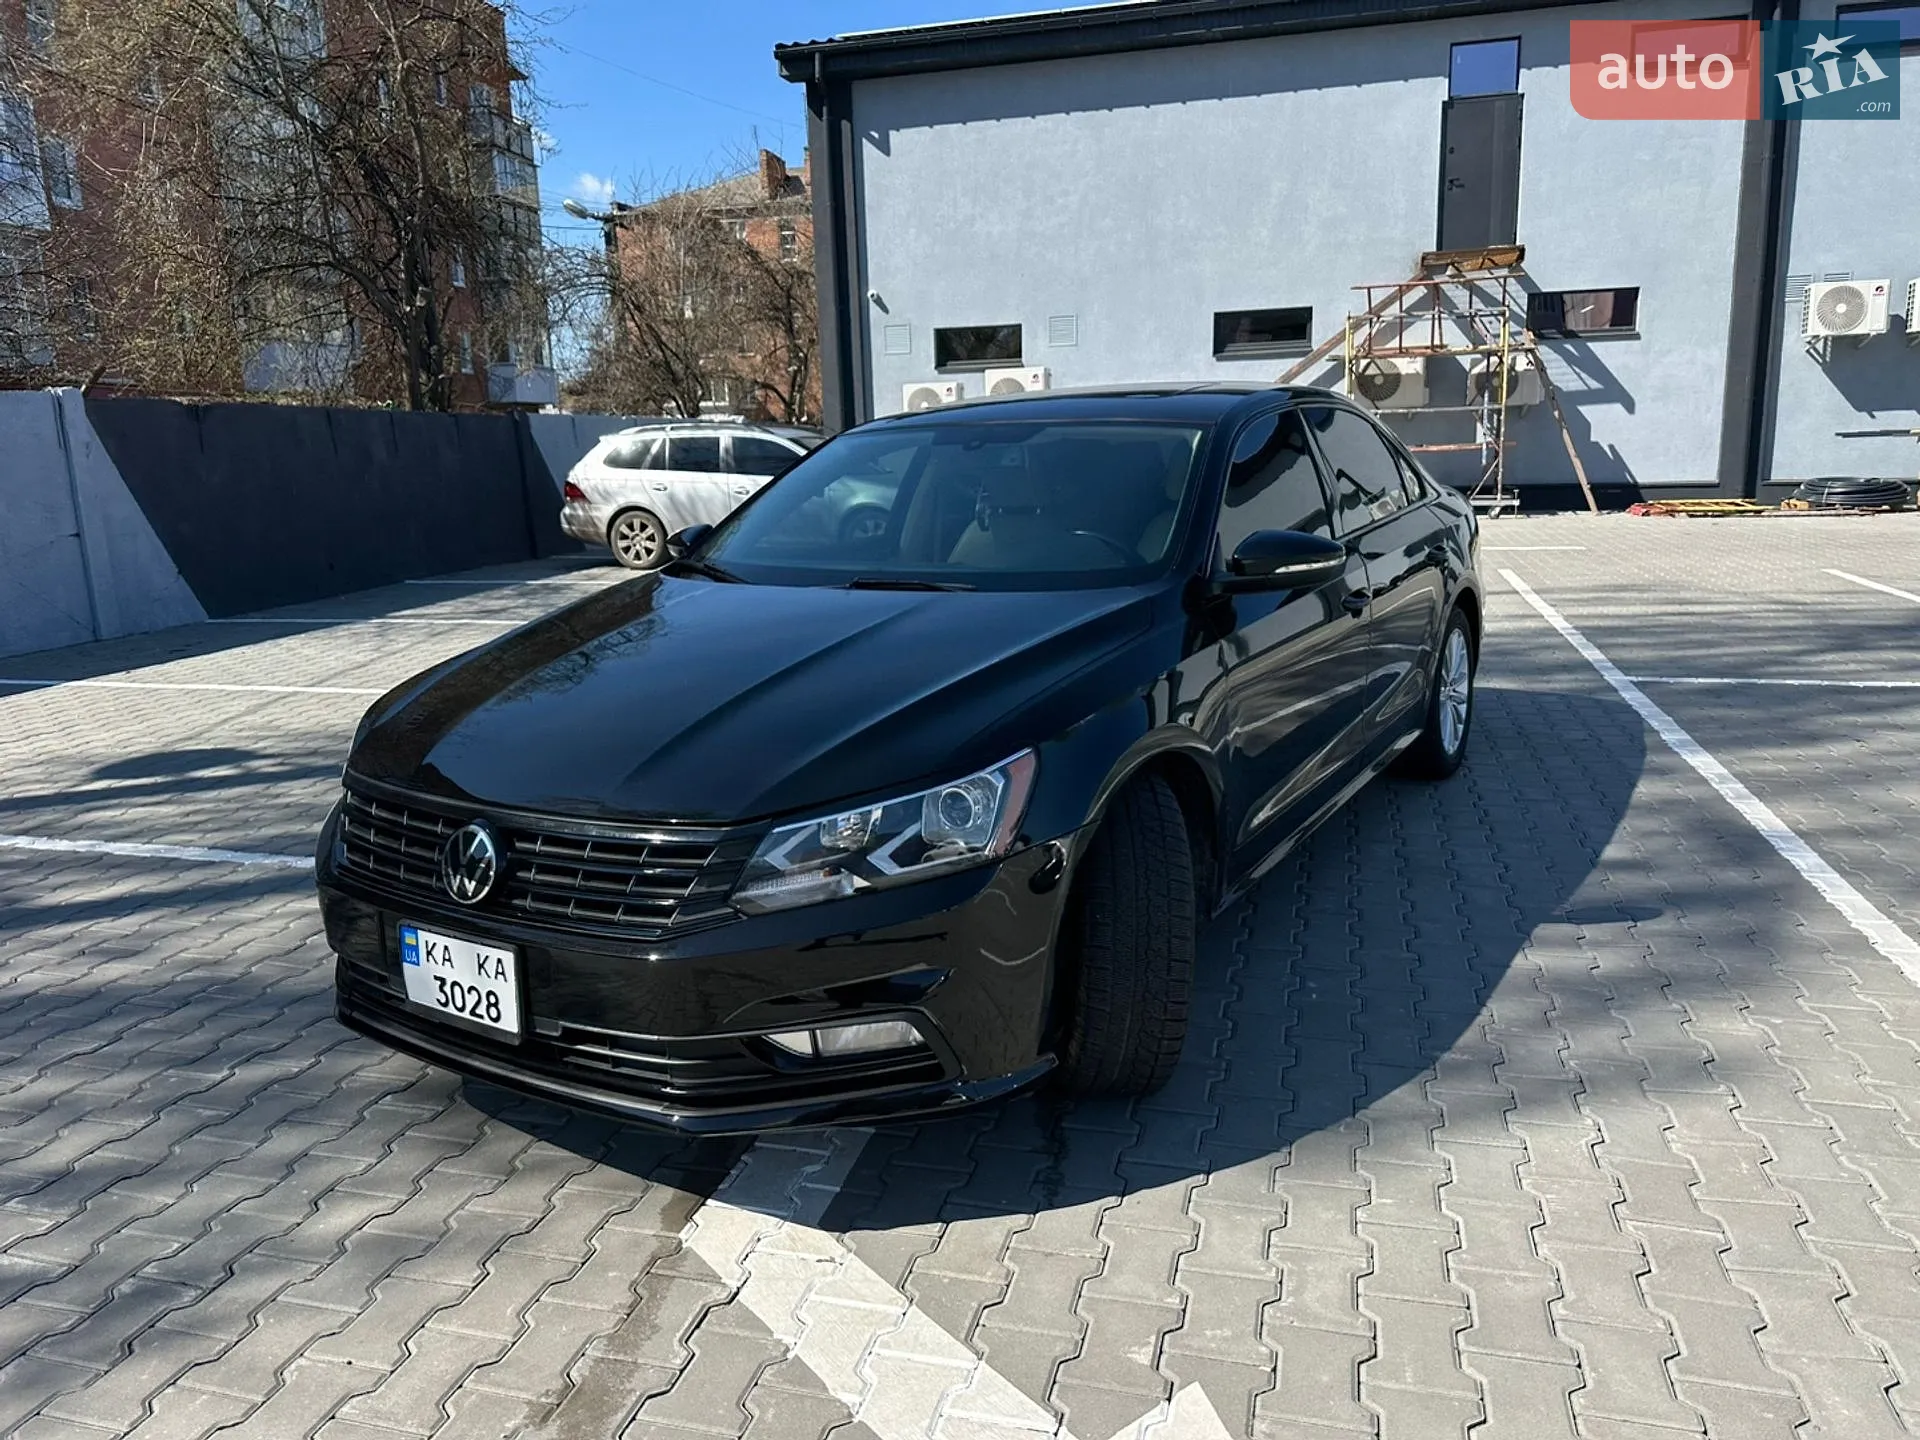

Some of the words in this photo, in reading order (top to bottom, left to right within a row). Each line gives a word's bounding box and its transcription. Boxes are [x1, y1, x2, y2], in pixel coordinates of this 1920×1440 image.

[405, 949, 418, 963] UA
[425, 940, 454, 969] KA
[477, 953, 508, 983] KA
[433, 974, 501, 1023] 3028
